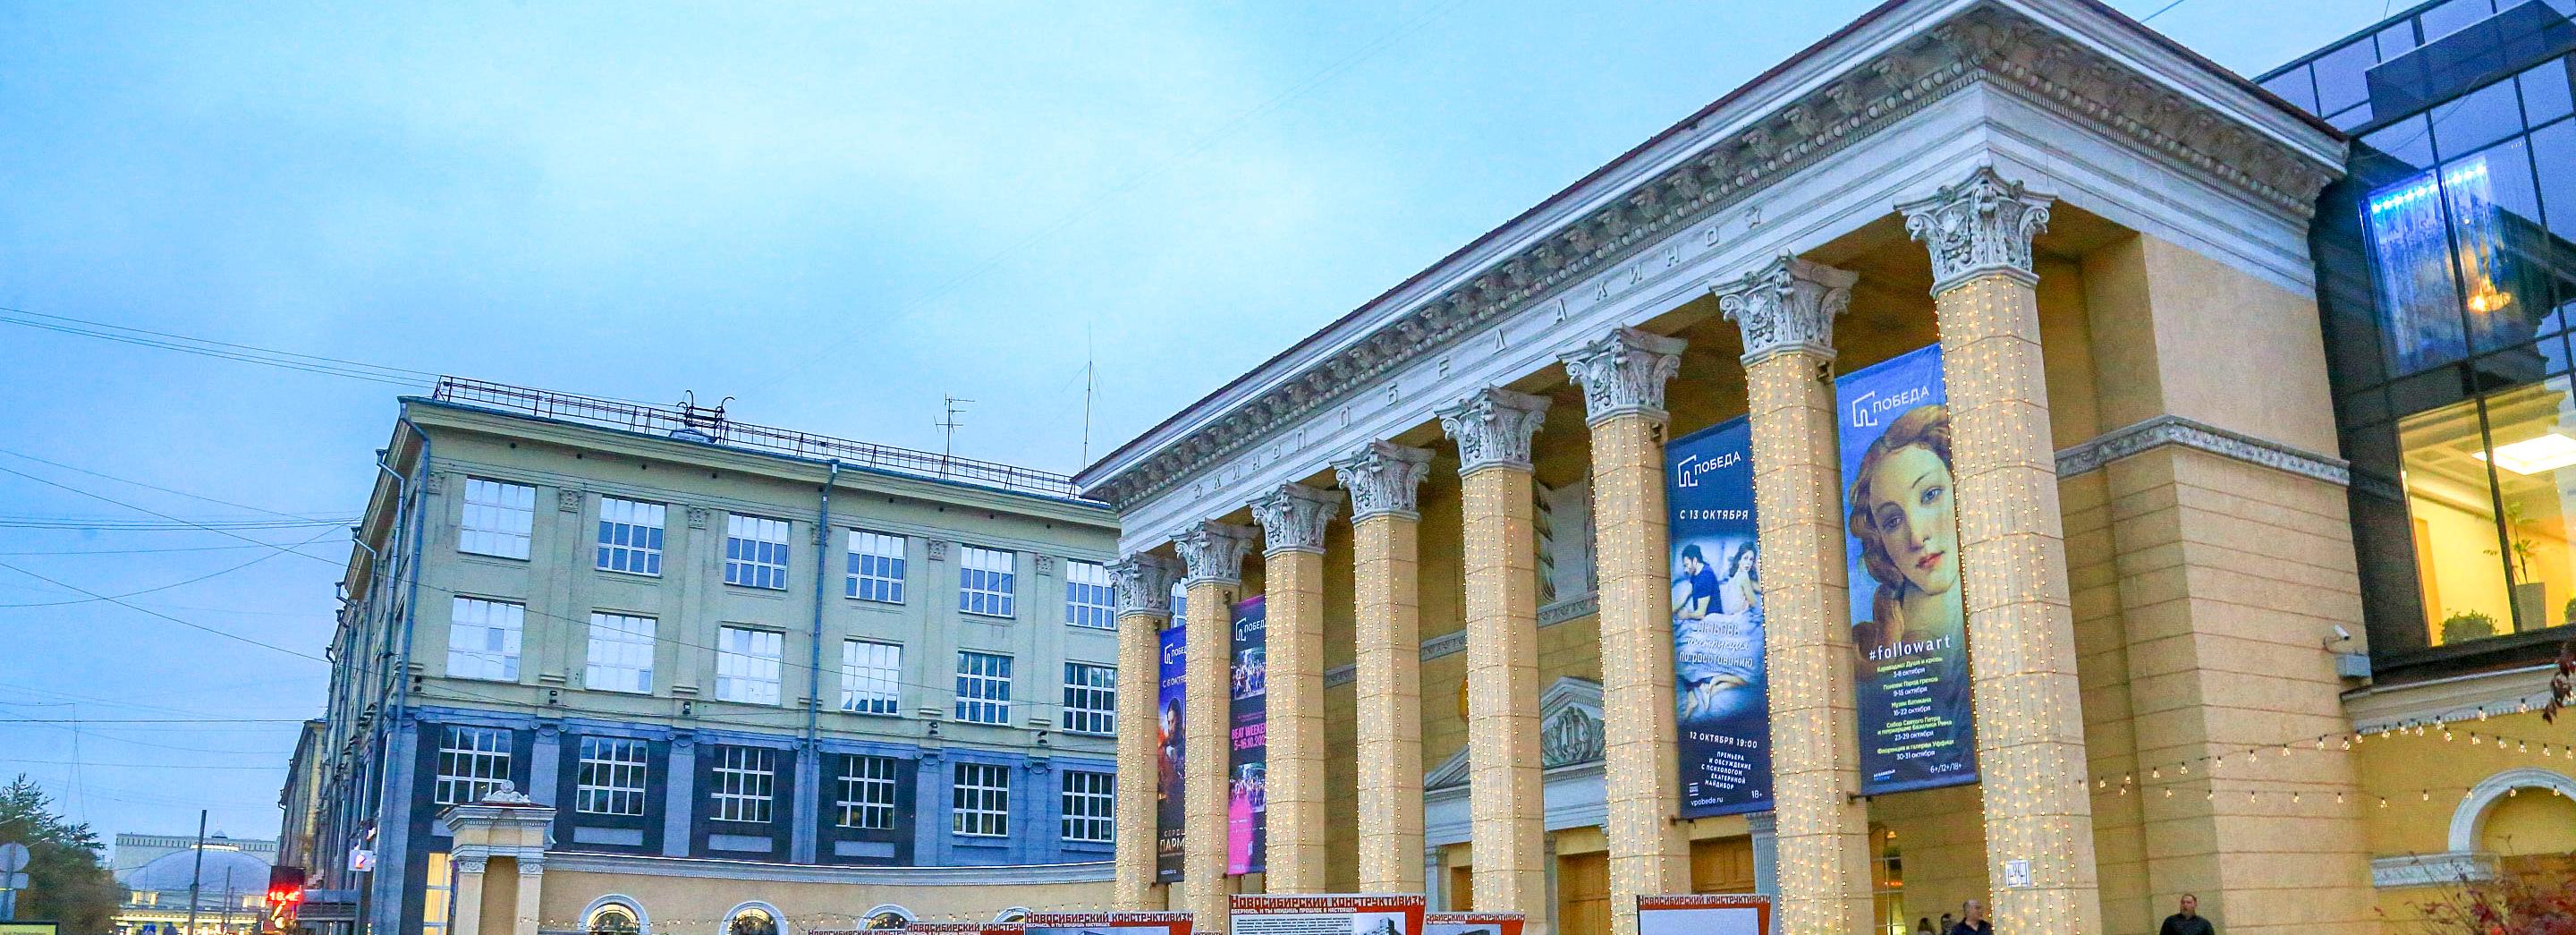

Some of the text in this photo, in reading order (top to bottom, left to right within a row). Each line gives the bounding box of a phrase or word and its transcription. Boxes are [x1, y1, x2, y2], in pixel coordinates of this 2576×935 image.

[1296, 298, 1567, 451] ПОБЕДА
[1596, 225, 1719, 302] КИНО
[1873, 386, 1929, 413] ПОБЕДА
[1694, 451, 1741, 476] ПОБЕДА
[1680, 509, 1749, 520] С 13 ОКТЯБРЯ
[1868, 634, 1951, 661] #followart
[1690, 731, 1758, 749] 12 ОКТЯБРЯ 19:00
[1716, 752, 1744, 761] ПРЕМЬЕРА
[1714, 759, 1751, 770] ОБСУЖДЕНИЕ
[1707, 765, 1742, 776] ПСИХОЛОГОМ
[1751, 789, 1762, 799] 18+
[1690, 797, 1724, 807] vpobede.ru
